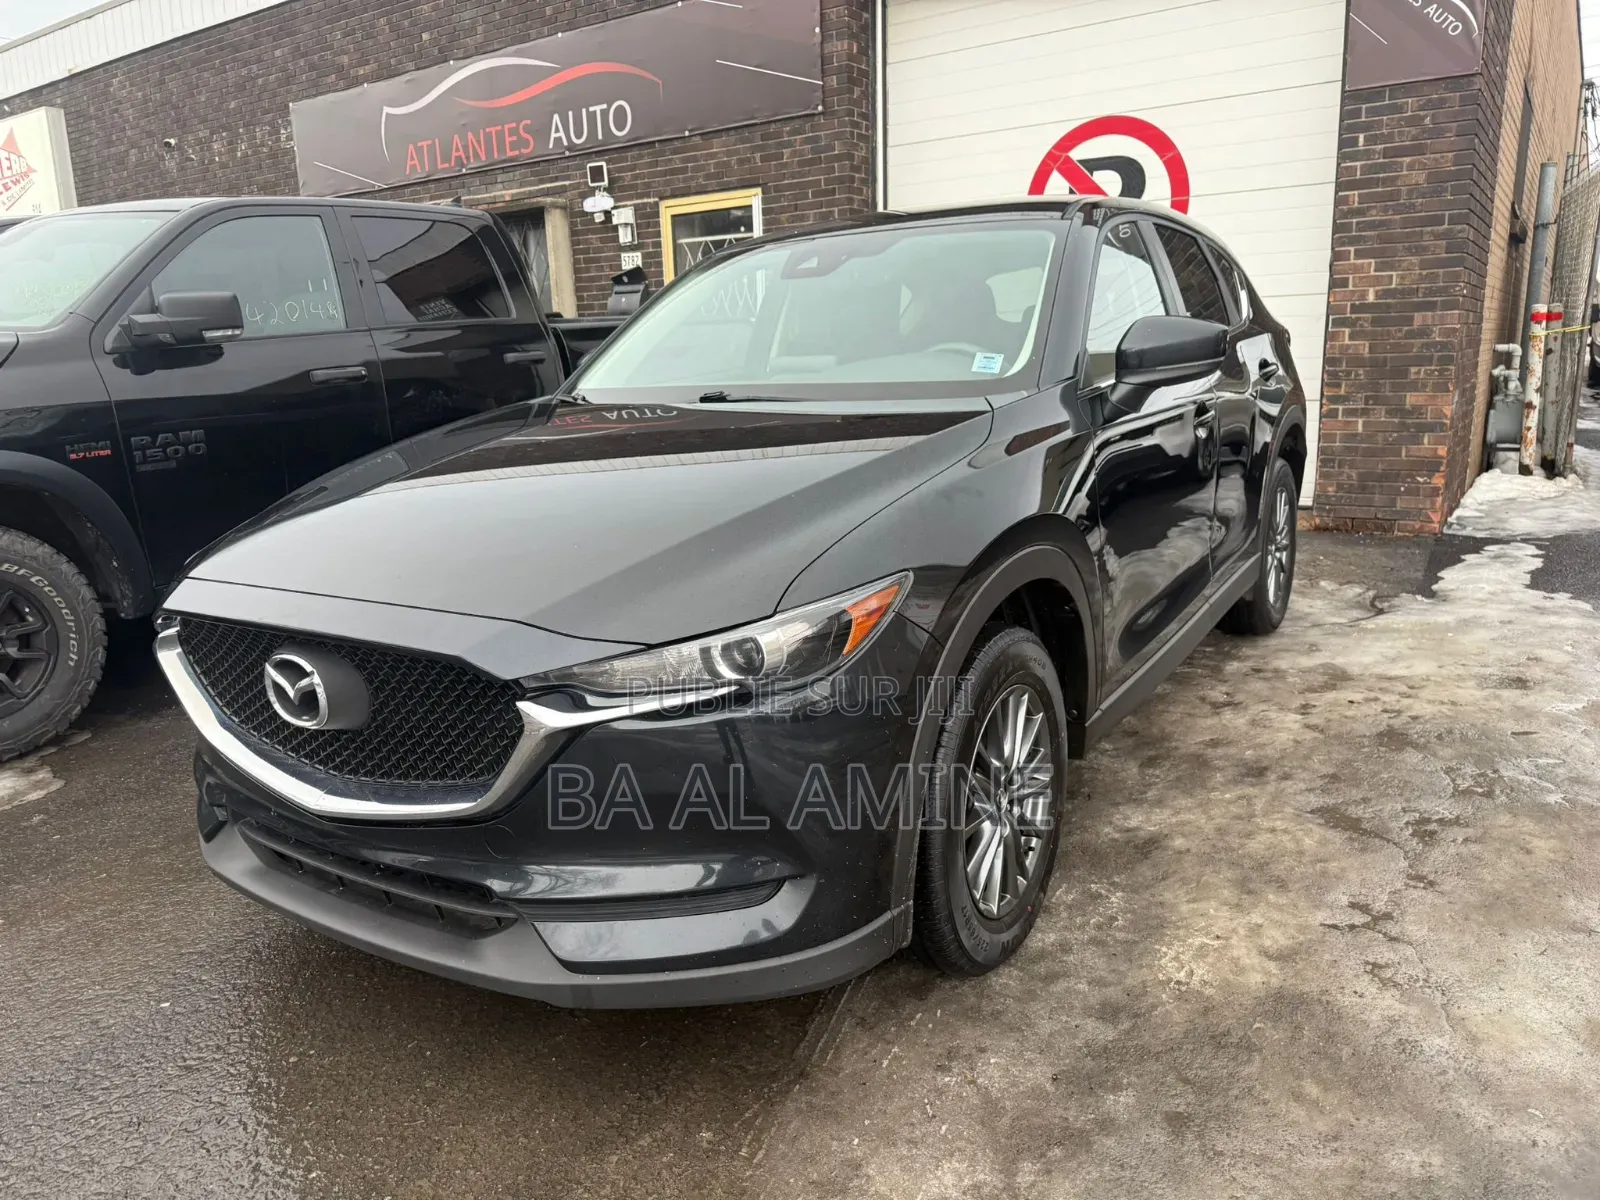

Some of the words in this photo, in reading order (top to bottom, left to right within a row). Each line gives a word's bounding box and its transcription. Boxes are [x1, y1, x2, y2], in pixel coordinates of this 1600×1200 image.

[1423, 3, 1463, 36] AUTO
[405, 119, 535, 176] ATLANTES
[548, 99, 632, 149] AUTO
[65, 440, 111, 457] HEMI
[130, 429, 205, 450] RAM
[86, 449, 112, 458] LITER
[133, 443, 208, 463] 1500
